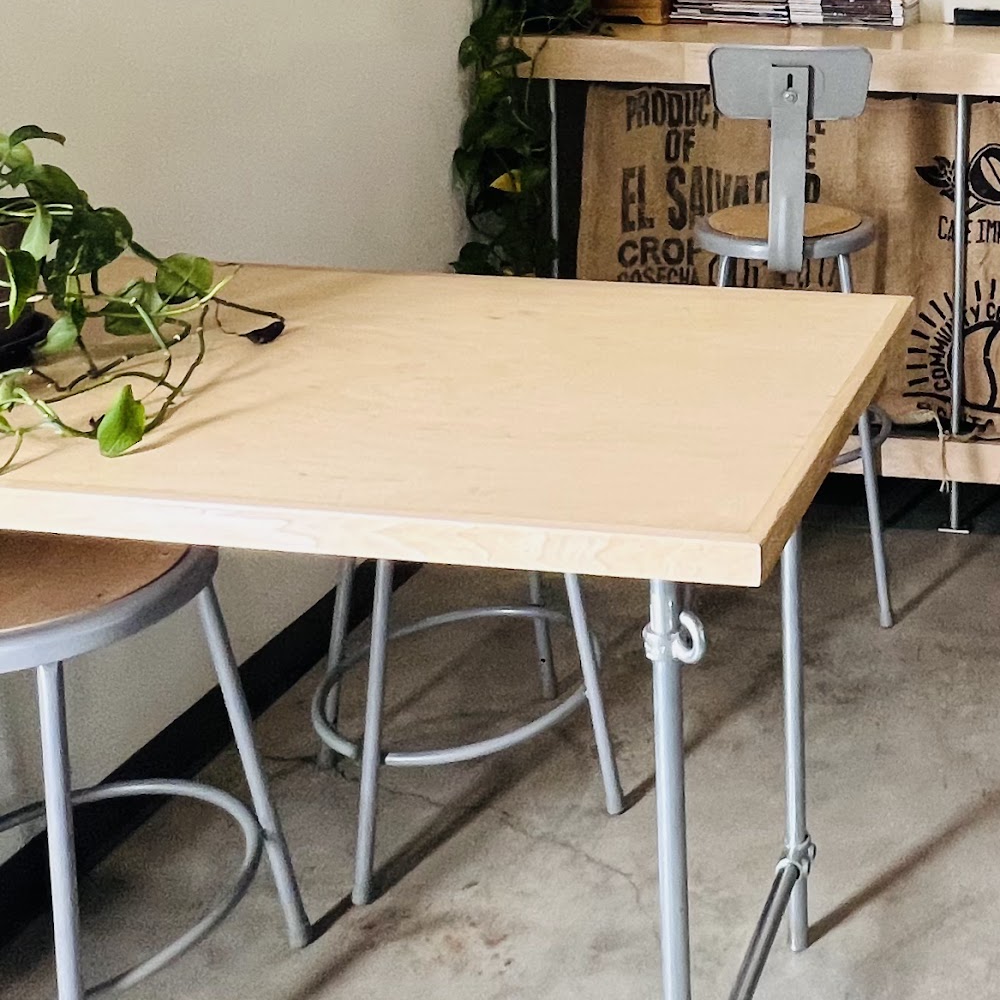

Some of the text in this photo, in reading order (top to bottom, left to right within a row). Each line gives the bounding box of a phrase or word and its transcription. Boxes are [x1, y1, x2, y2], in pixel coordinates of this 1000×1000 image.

[626, 89, 719, 131] PRODUC
[664, 128, 696, 163] OF
[622, 165, 655, 232] EL
[937, 215, 973, 244] CAE
